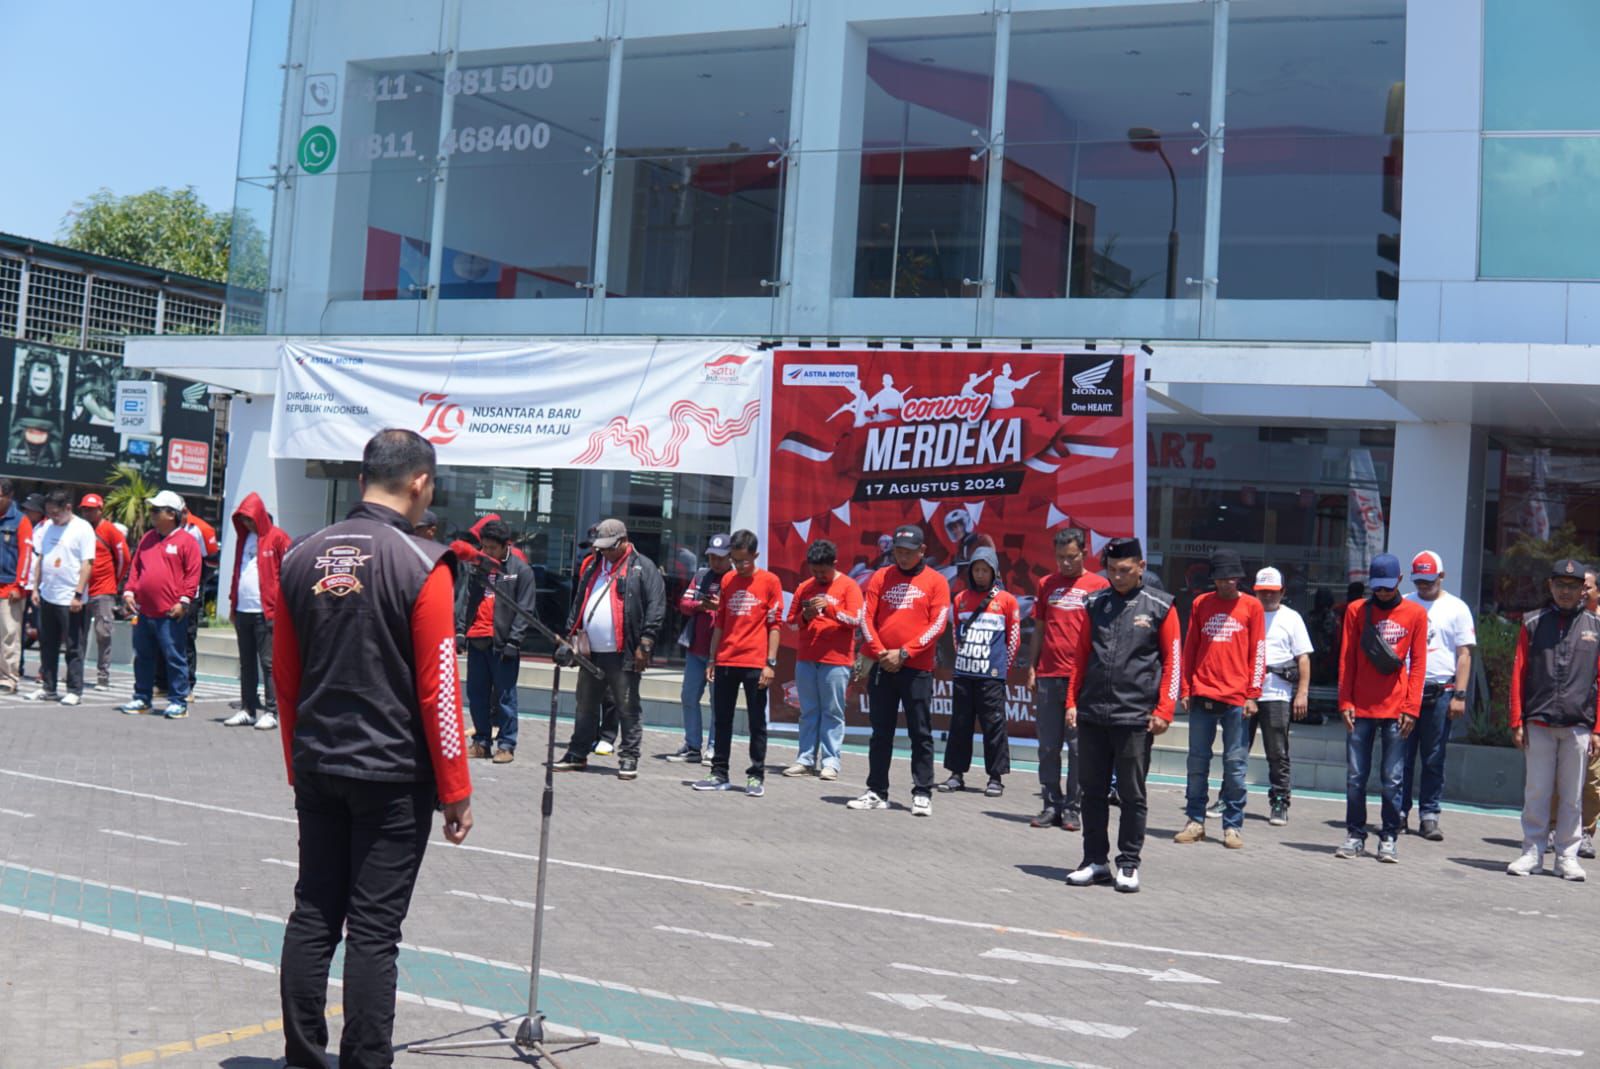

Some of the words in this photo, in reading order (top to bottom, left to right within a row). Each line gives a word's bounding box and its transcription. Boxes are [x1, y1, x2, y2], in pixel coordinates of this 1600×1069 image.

[287, 391, 335, 402] DIRGAHAYU
[1071, 388, 1114, 396] HONDA
[286, 404, 322, 413] REPUBLIK
[323, 405, 369, 415] INDONESIA
[472, 406, 544, 419] NUSANTARA
[547, 408, 582, 419] BARU
[902, 393, 990, 422] convoy
[1071, 402, 1087, 412] One
[121, 417, 145, 426] SHOP
[468, 423, 532, 434] INDONESIA
[535, 424, 571, 435] MAJU
[70, 434, 91, 449] 650
[863, 417, 1022, 472] MERDEKA
[171, 444, 183, 469] 5
[865, 484, 884, 496] 17
[964, 478, 1006, 490] 2024
[955, 656, 990, 673] ENJOY
